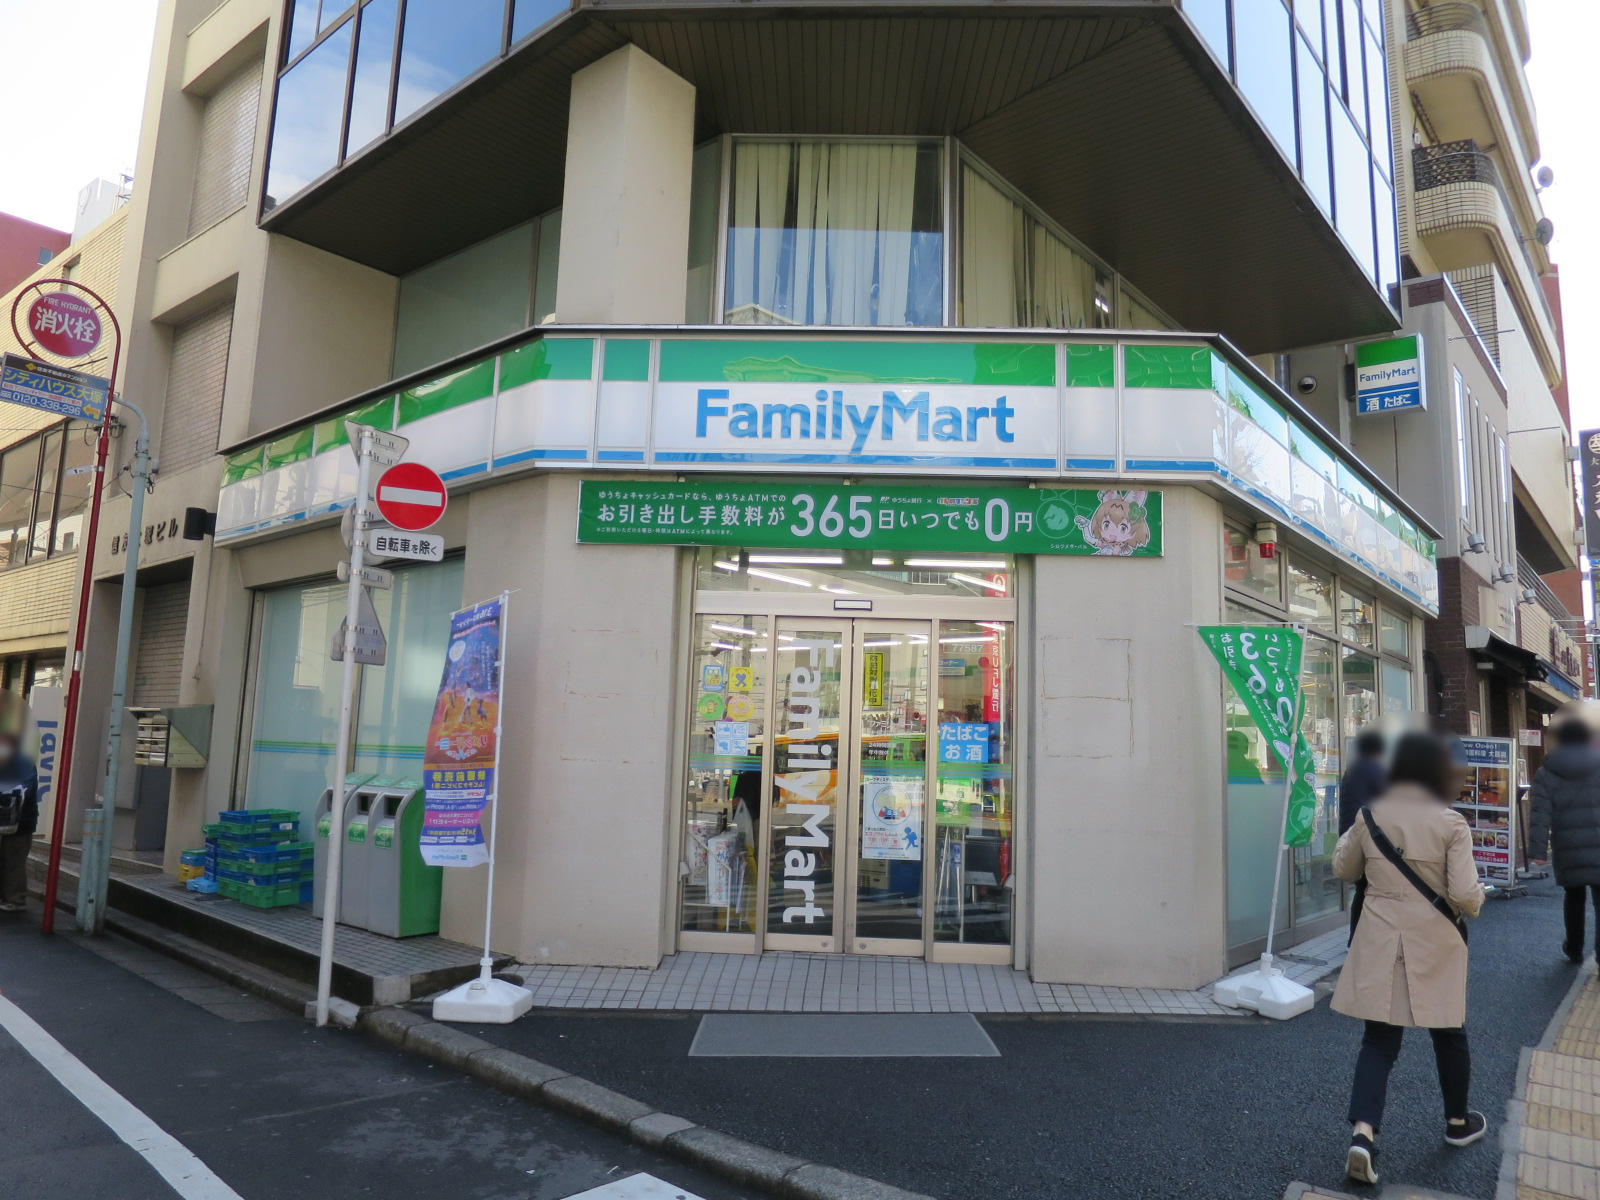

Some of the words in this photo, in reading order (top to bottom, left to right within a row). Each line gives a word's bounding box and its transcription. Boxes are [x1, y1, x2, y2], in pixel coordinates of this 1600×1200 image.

[43, 297, 59, 306] FIRE
[60, 301, 92, 315] HYDRANT
[35, 304, 97, 344] 消火栓
[1359, 366, 1416, 382] FamilyMart
[4, 369, 103, 404] シティハウス大塚
[12, 392, 81, 416] 0120-338-296
[1366, 397, 1380, 411] 酒
[1384, 394, 1412, 408] たばこ
[695, 388, 1015, 455] FamilyMart
[376, 536, 439, 556] 自転車を除く
[940, 724, 988, 742] たばこ
[944, 744, 983, 762] お酒
[774, 639, 835, 924] FamilyMart
